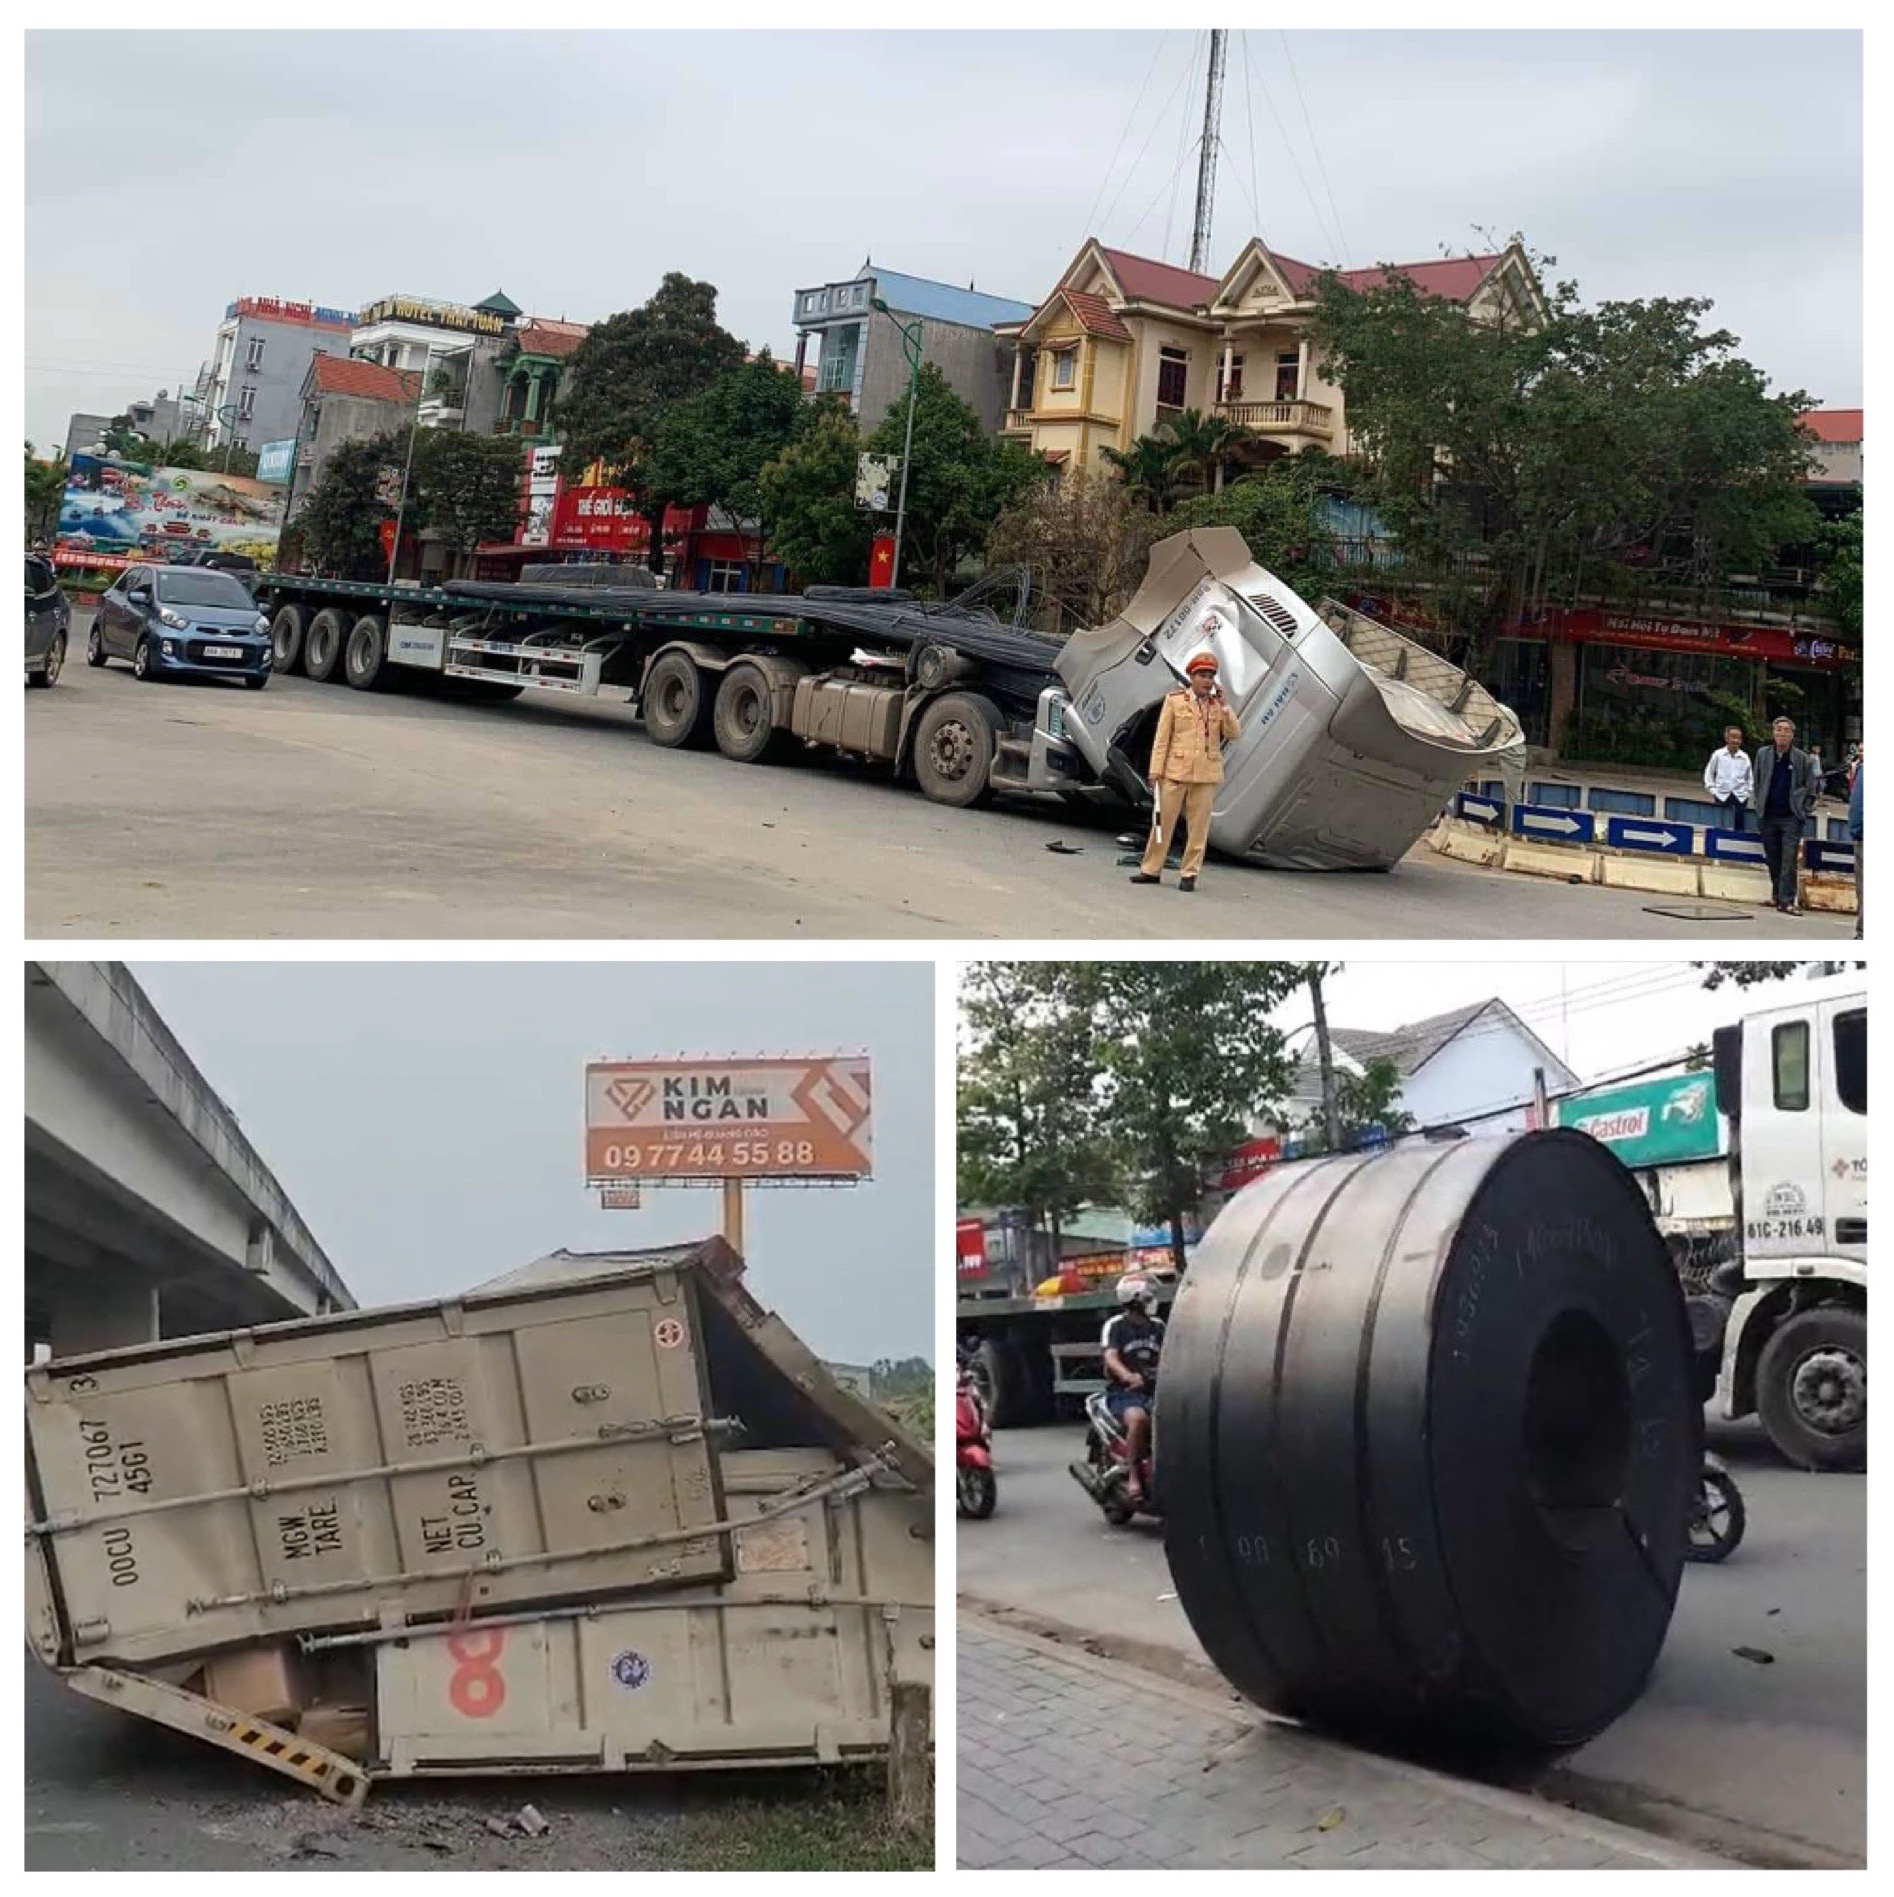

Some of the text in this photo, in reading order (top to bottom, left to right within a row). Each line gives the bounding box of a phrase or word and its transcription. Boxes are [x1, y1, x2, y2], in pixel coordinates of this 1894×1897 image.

[398, 300, 433, 321] HOTEL
[663, 1076, 731, 1098] KIM
[663, 1098, 768, 1121] NGAN
[1590, 1111, 1645, 1138] Castrol
[605, 1145, 641, 1168] 09
[732, 1142, 770, 1166] 55
[777, 1141, 814, 1165] 88
[70, 1375, 97, 1393] 3
[79, 1419, 122, 1503] 727067
[118, 1441, 153, 1494] 45G1
[278, 1516, 312, 1559] MGW
[420, 1516, 452, 1554] NET
